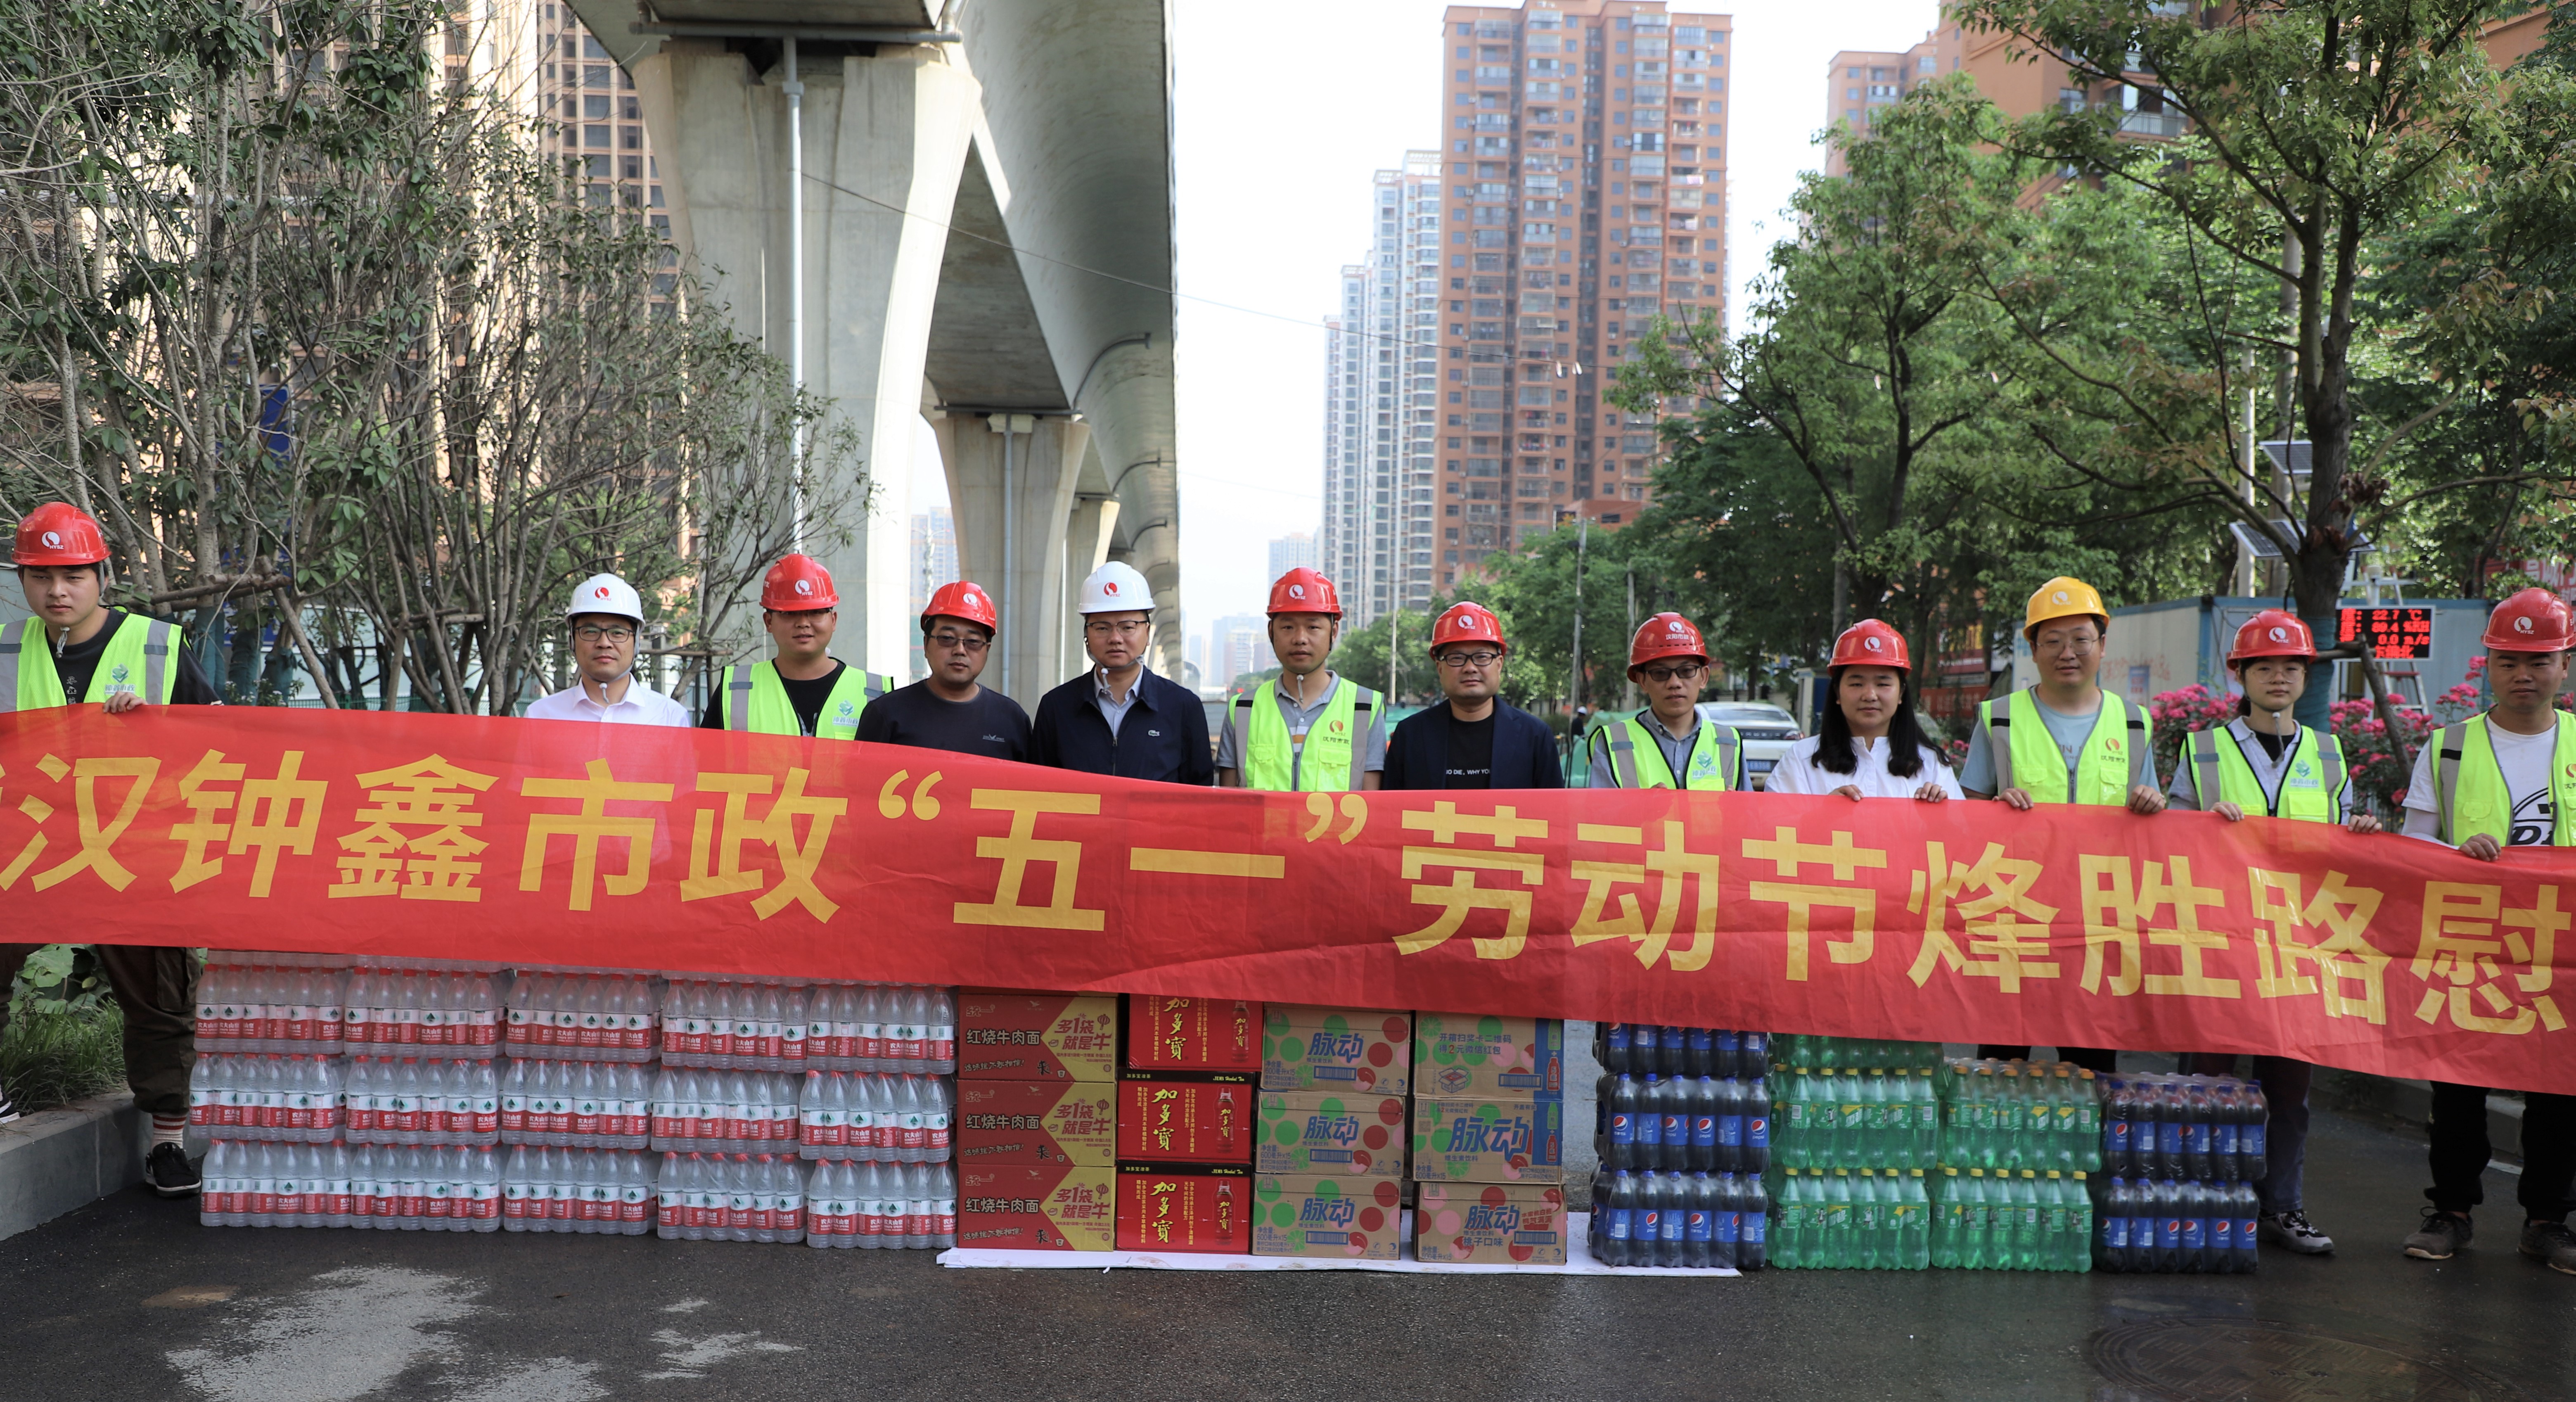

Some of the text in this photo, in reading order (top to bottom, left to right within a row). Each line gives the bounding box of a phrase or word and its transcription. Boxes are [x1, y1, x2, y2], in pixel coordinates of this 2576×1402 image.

[2372, 609, 2400, 620] 22.7
[2378, 633, 2430, 645] 0.0 m/s
[1054, 1018, 1095, 1034] 多1袋
[966, 1029, 1040, 1045] 红烧牛肉面
[1062, 1033, 1112, 1051] 就是牛
[1440, 1033, 1512, 1044] 开箱扫奖卡二维码
[1308, 1032, 1364, 1063] 脉动
[1439, 1045, 1500, 1055] 得2元微信红包
[1054, 1103, 1094, 1119] 多1袋
[966, 1113, 1040, 1129] 红烧牛肉面
[1062, 1118, 1111, 1135] 就是牛
[1303, 1115, 1359, 1146] 脉动
[1446, 1117, 1529, 1162] 脉动
[1053, 1187, 1093, 1203] 多1袋
[965, 1197, 1039, 1214] 红烧牛肉面
[1061, 1202, 1110, 1219] 就是牛
[1299, 1198, 1355, 1228] 脉动
[1465, 1205, 1519, 1235] 脉动
[1463, 1237, 1503, 1247] 桃子口味
